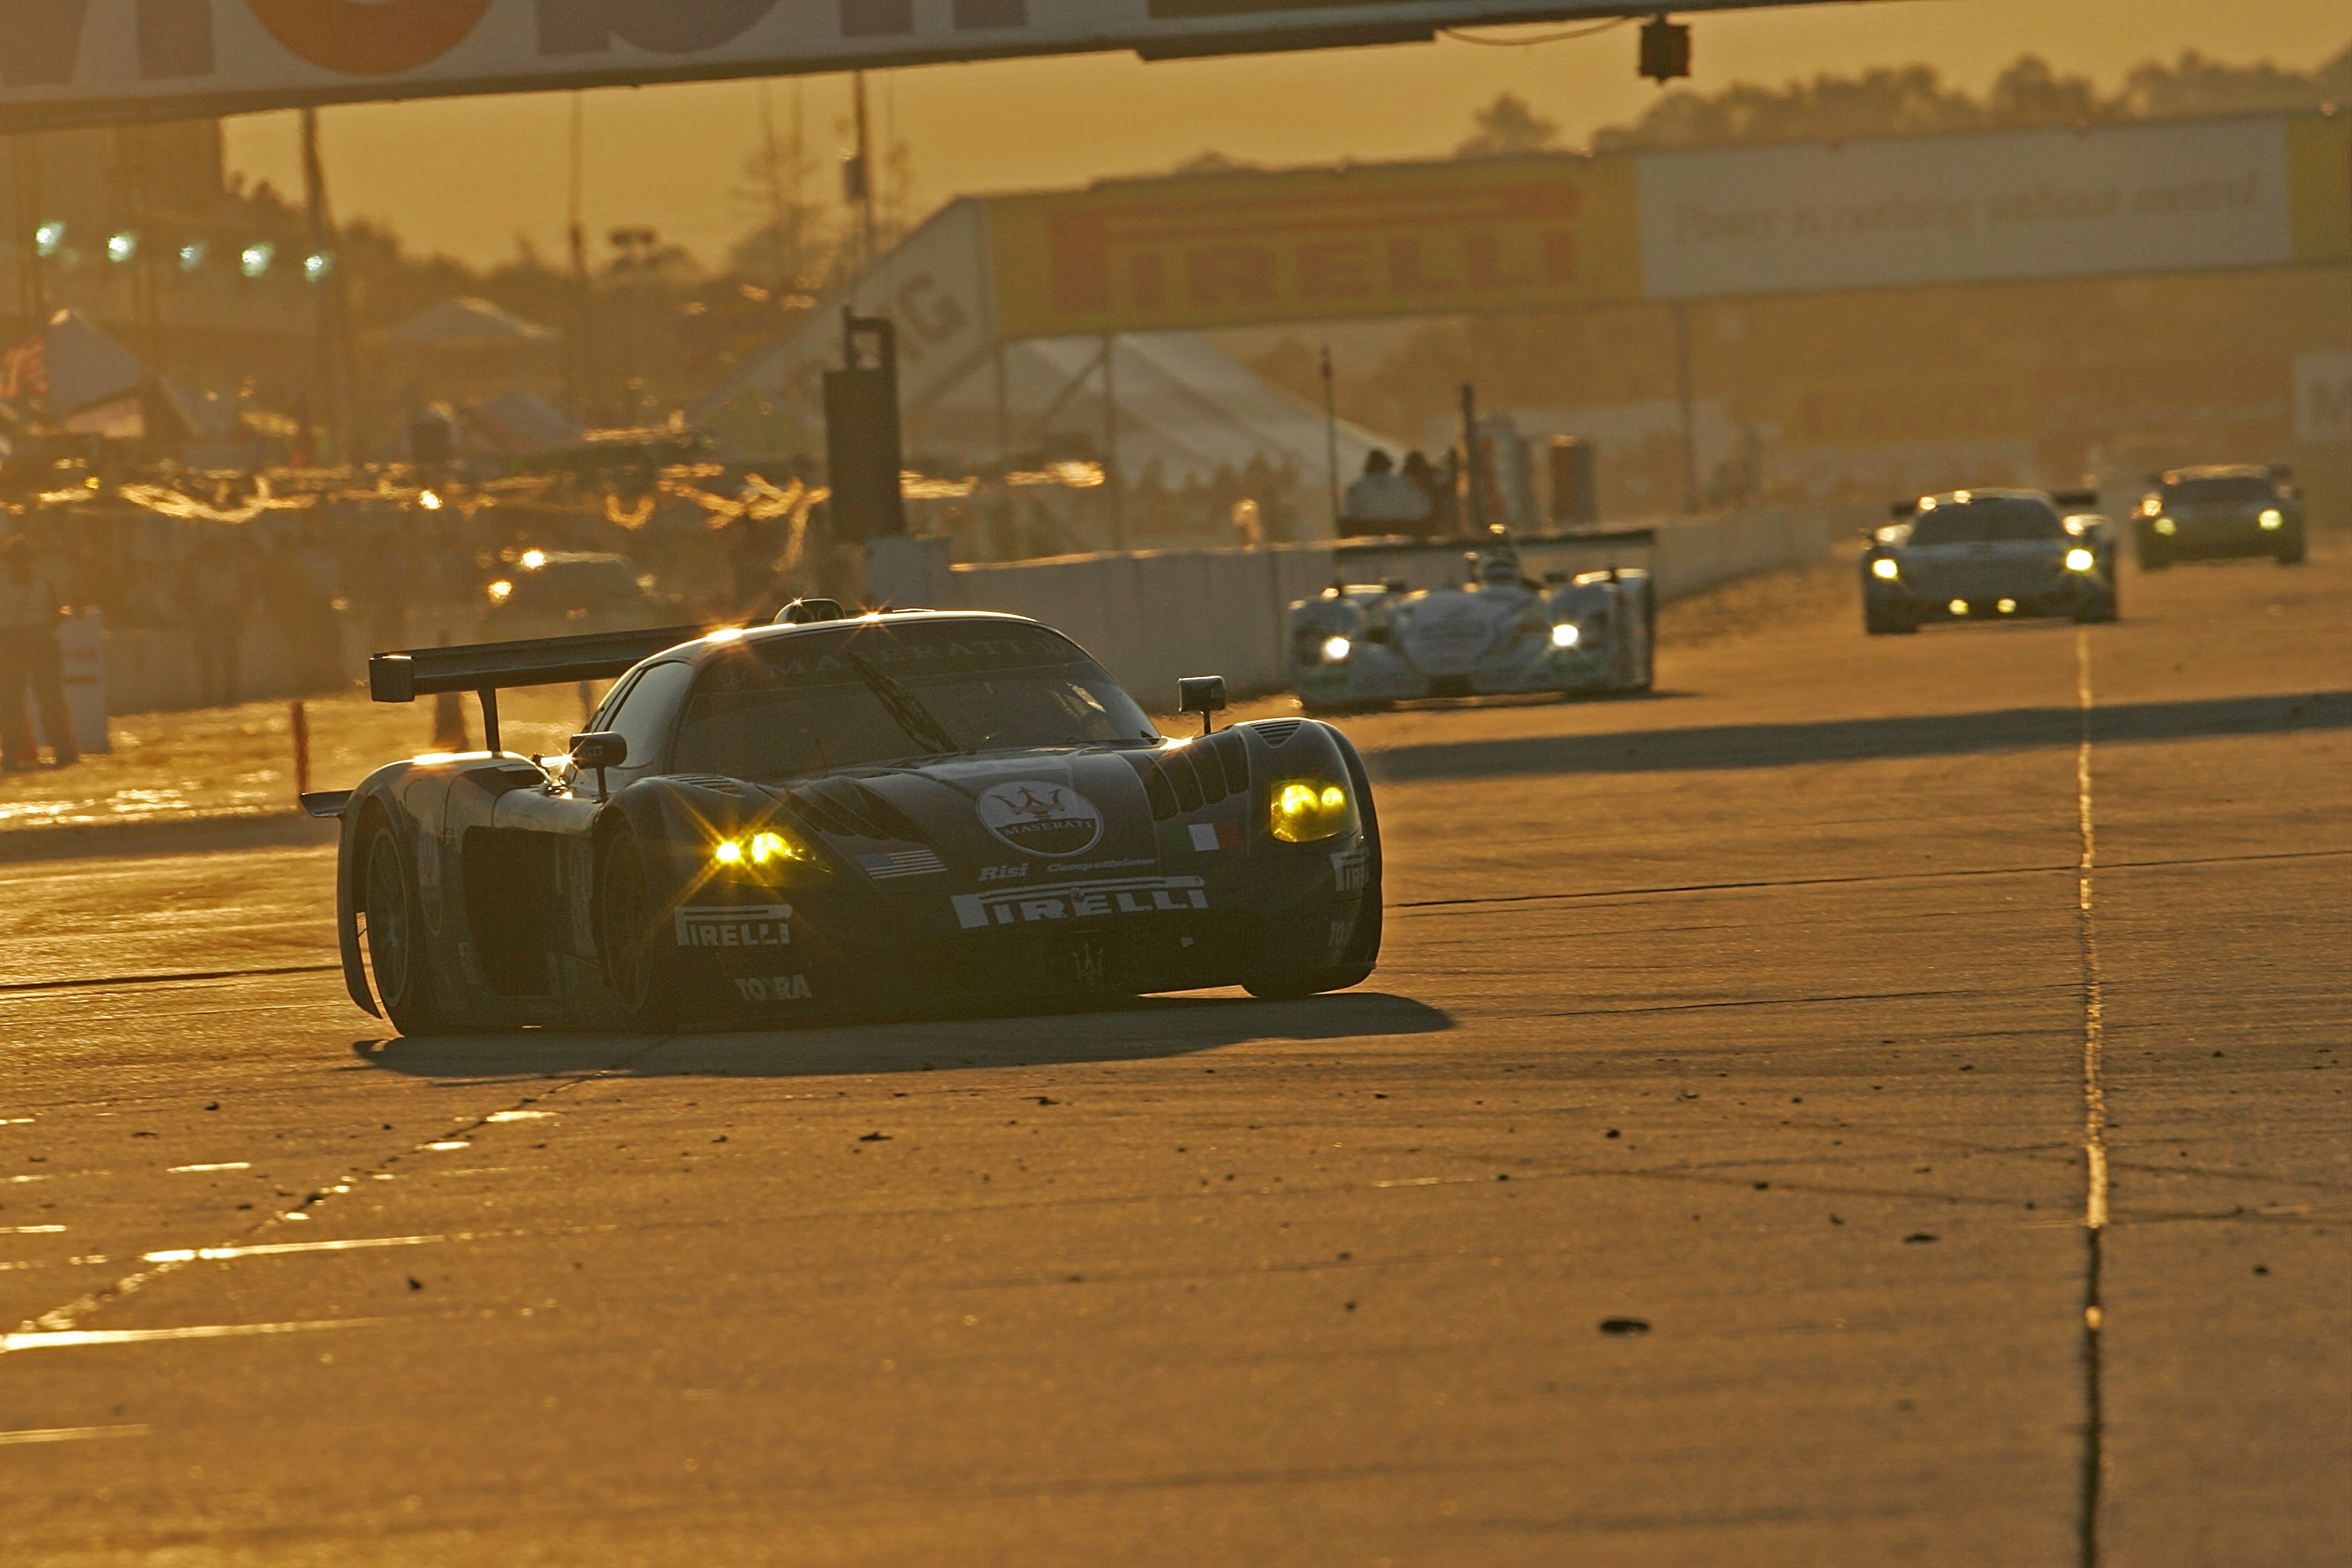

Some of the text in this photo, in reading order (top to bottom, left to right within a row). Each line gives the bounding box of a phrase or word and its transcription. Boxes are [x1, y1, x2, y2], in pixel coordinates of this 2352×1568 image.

[1046, 184, 1582, 312] PIRELLI
[768, 640, 1028, 678] MASERATI
[1003, 820, 1091, 837] MASERATI
[977, 863, 1030, 881] Risi
[950, 875, 1210, 930] PIRELLI
[674, 903, 793, 946] PIRELLI
